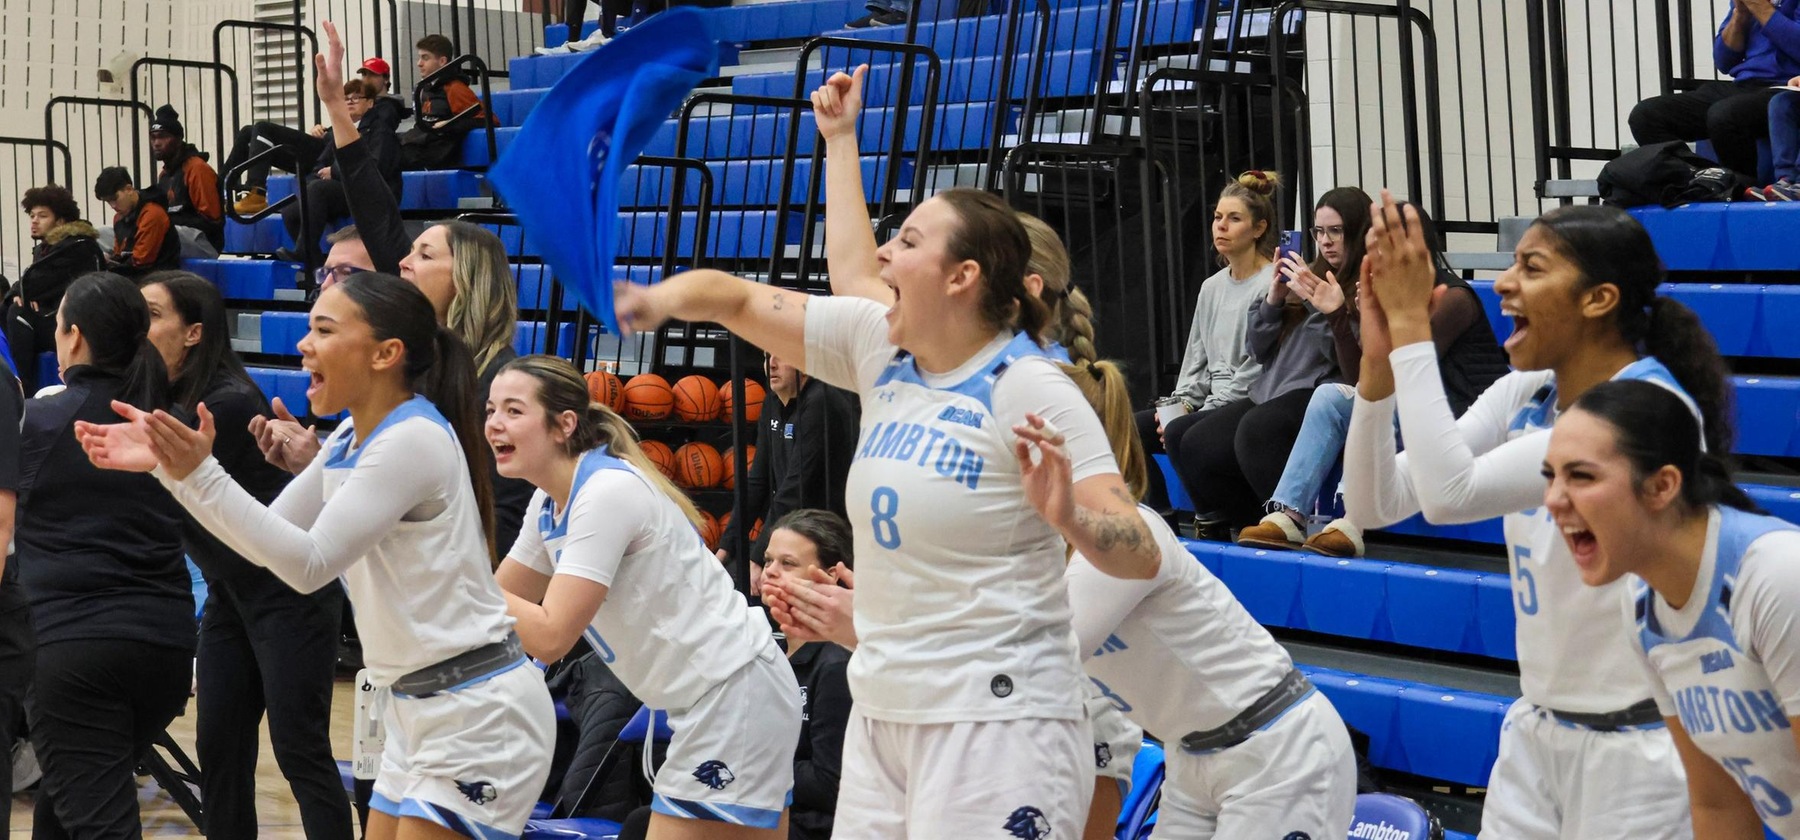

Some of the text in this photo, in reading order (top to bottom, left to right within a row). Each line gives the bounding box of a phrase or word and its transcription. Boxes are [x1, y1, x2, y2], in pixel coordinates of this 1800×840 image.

[853, 421, 984, 490] AMBTON
[870, 486, 901, 550] 8
[1513, 544, 1538, 616] 5
[1676, 685, 1791, 734] MBTON
